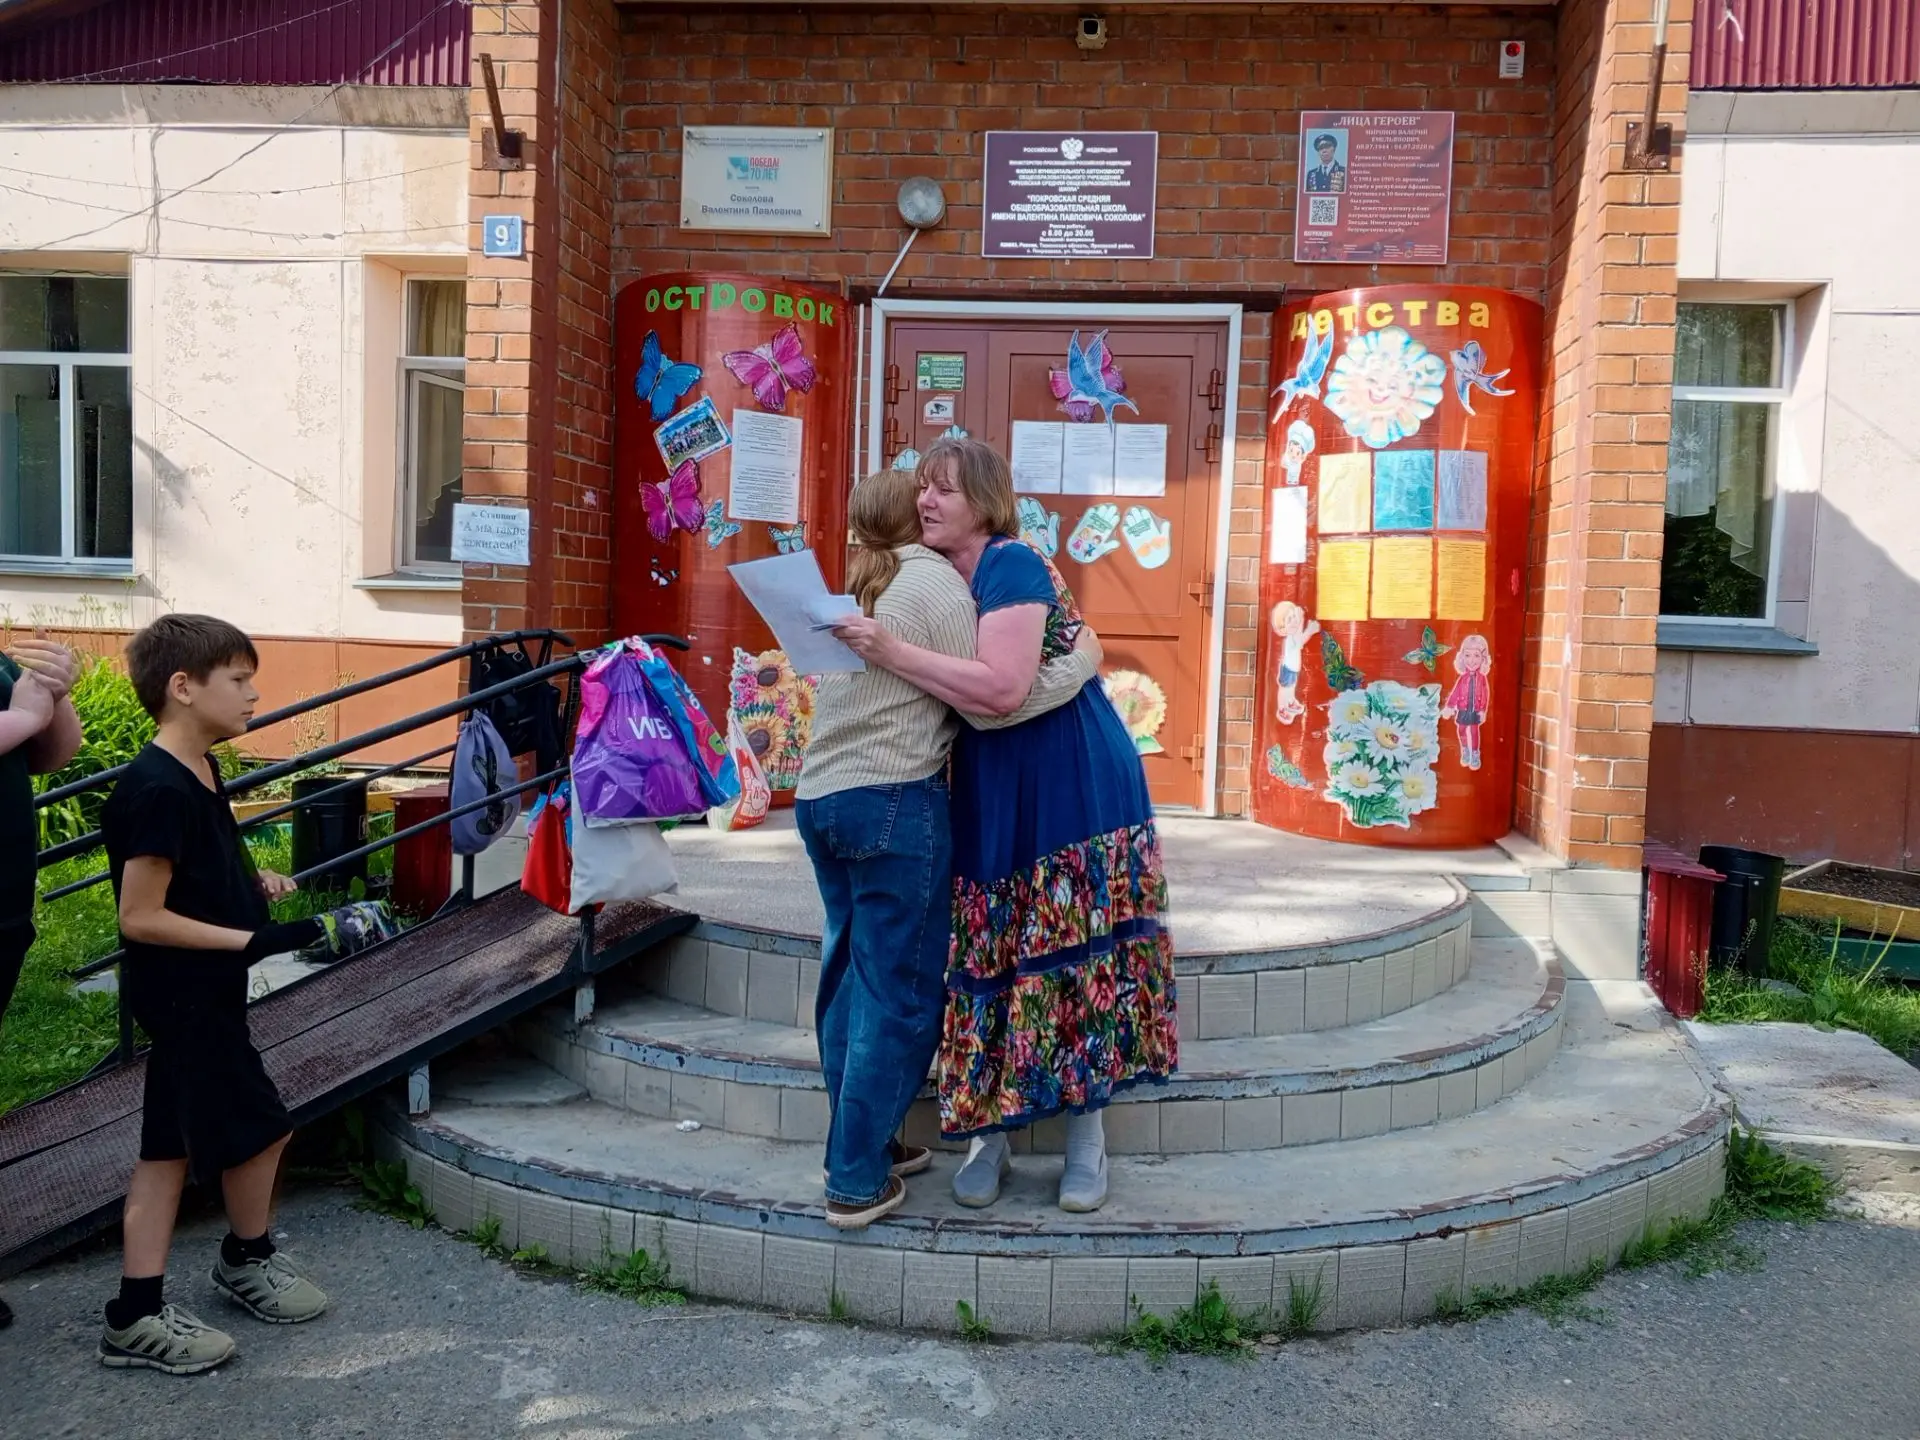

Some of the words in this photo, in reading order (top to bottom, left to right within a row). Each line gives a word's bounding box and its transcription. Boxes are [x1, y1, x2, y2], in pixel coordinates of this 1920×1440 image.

[750, 157, 780, 168] ПОБЕДА!
[750, 168, 760, 180] 70
[762, 168, 778, 180] ЛЕТ
[730, 194, 774, 204] Соколова
[1078, 196, 1111, 204] СРЕДНЯЯ
[701, 205, 750, 216] Валентина
[752, 206, 802, 216] Павловича
[1010, 204, 1100, 213] ОБЩЕОБРАЗОВАТЕЛЬНАЯ
[1101, 204, 1126, 212] ШКОЛА
[1017, 213, 1059, 221] ВАЛЕНТИНА
[1060, 213, 1103, 222] ПАВЛОВИЧА
[495, 224, 509, 247] 9
[645, 281, 834, 326] ОСТРОВОК
[1290, 300, 1490, 341] детства
[628, 716, 672, 740] WB
